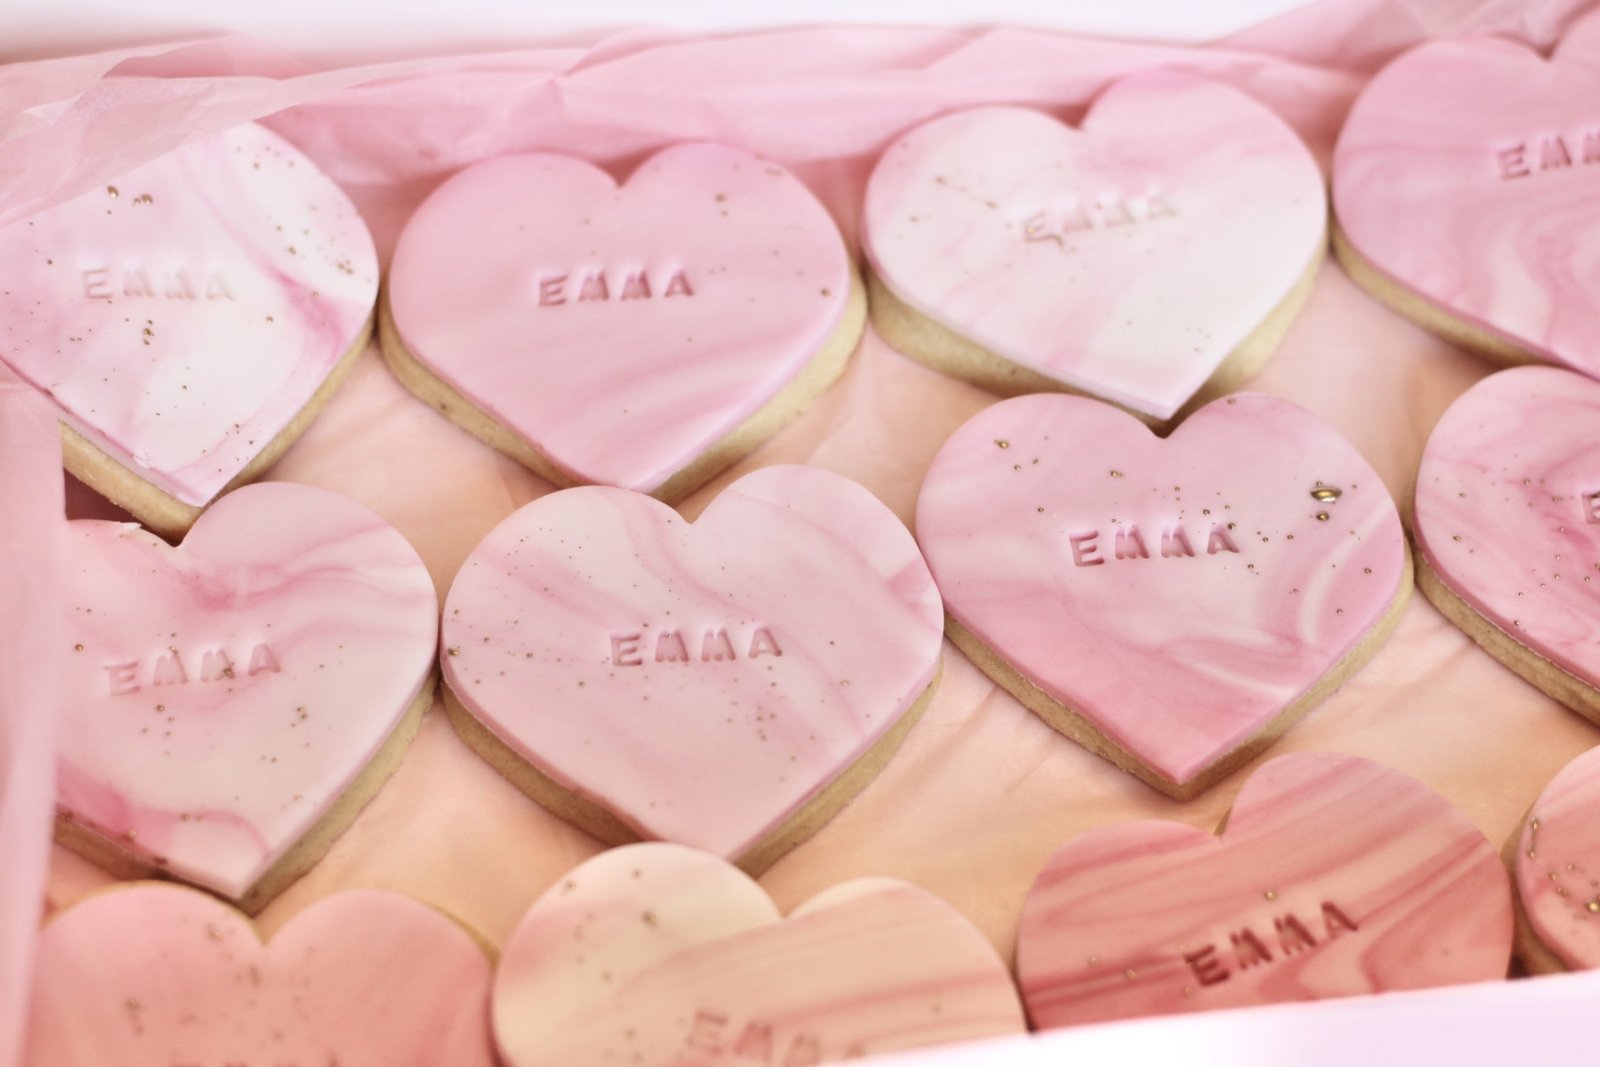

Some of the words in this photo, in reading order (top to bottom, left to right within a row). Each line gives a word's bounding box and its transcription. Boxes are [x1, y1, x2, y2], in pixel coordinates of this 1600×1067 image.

[82, 264, 236, 300] EMMA
[538, 269, 695, 306] EMMA
[1070, 523, 1240, 567] EMMA
[610, 626, 783, 666] EMMA
[107, 643, 281, 696] EMMA
[1185, 901, 1359, 987] EMMA
